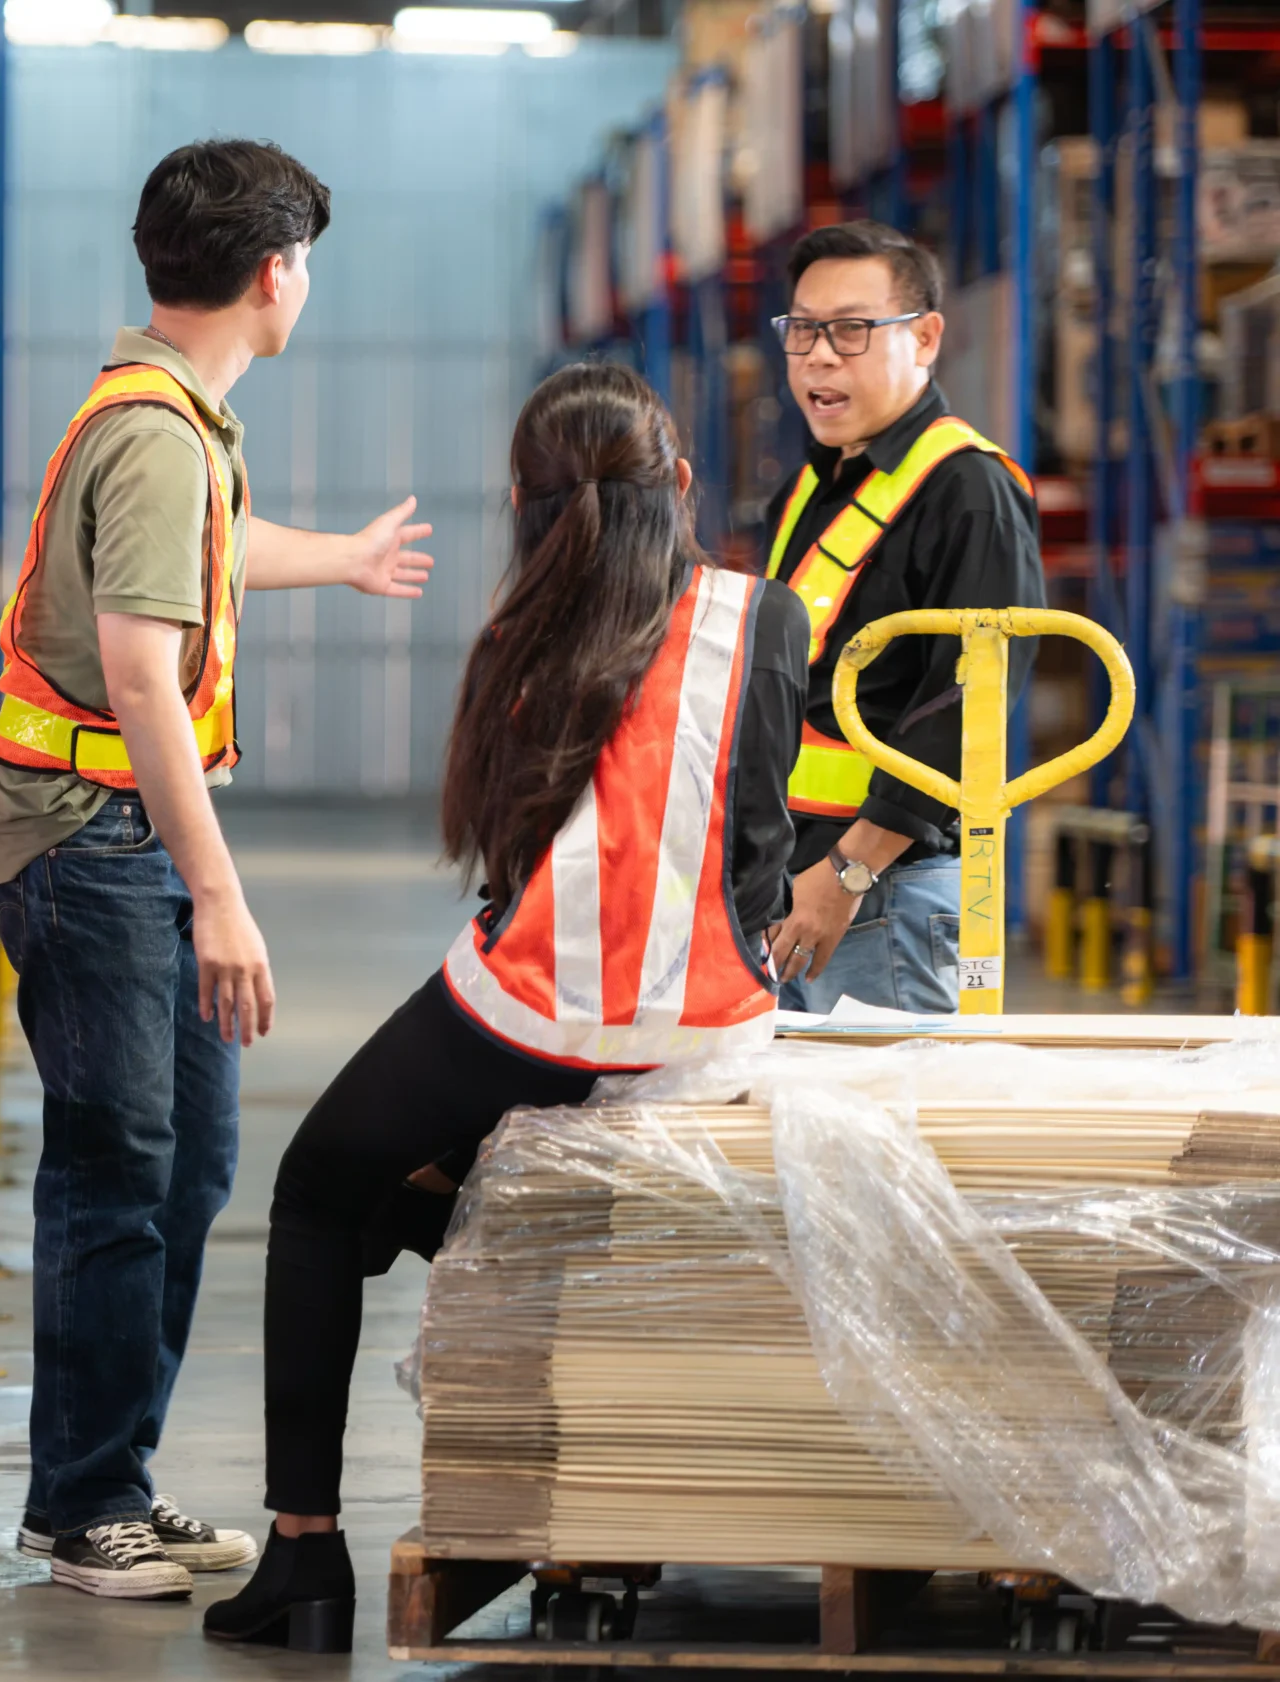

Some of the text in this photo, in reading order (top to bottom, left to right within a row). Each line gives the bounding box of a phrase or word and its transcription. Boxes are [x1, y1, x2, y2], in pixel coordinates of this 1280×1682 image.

[968, 838, 996, 920] RTV
[959, 960, 993, 971] STC
[967, 975, 985, 987] 21
